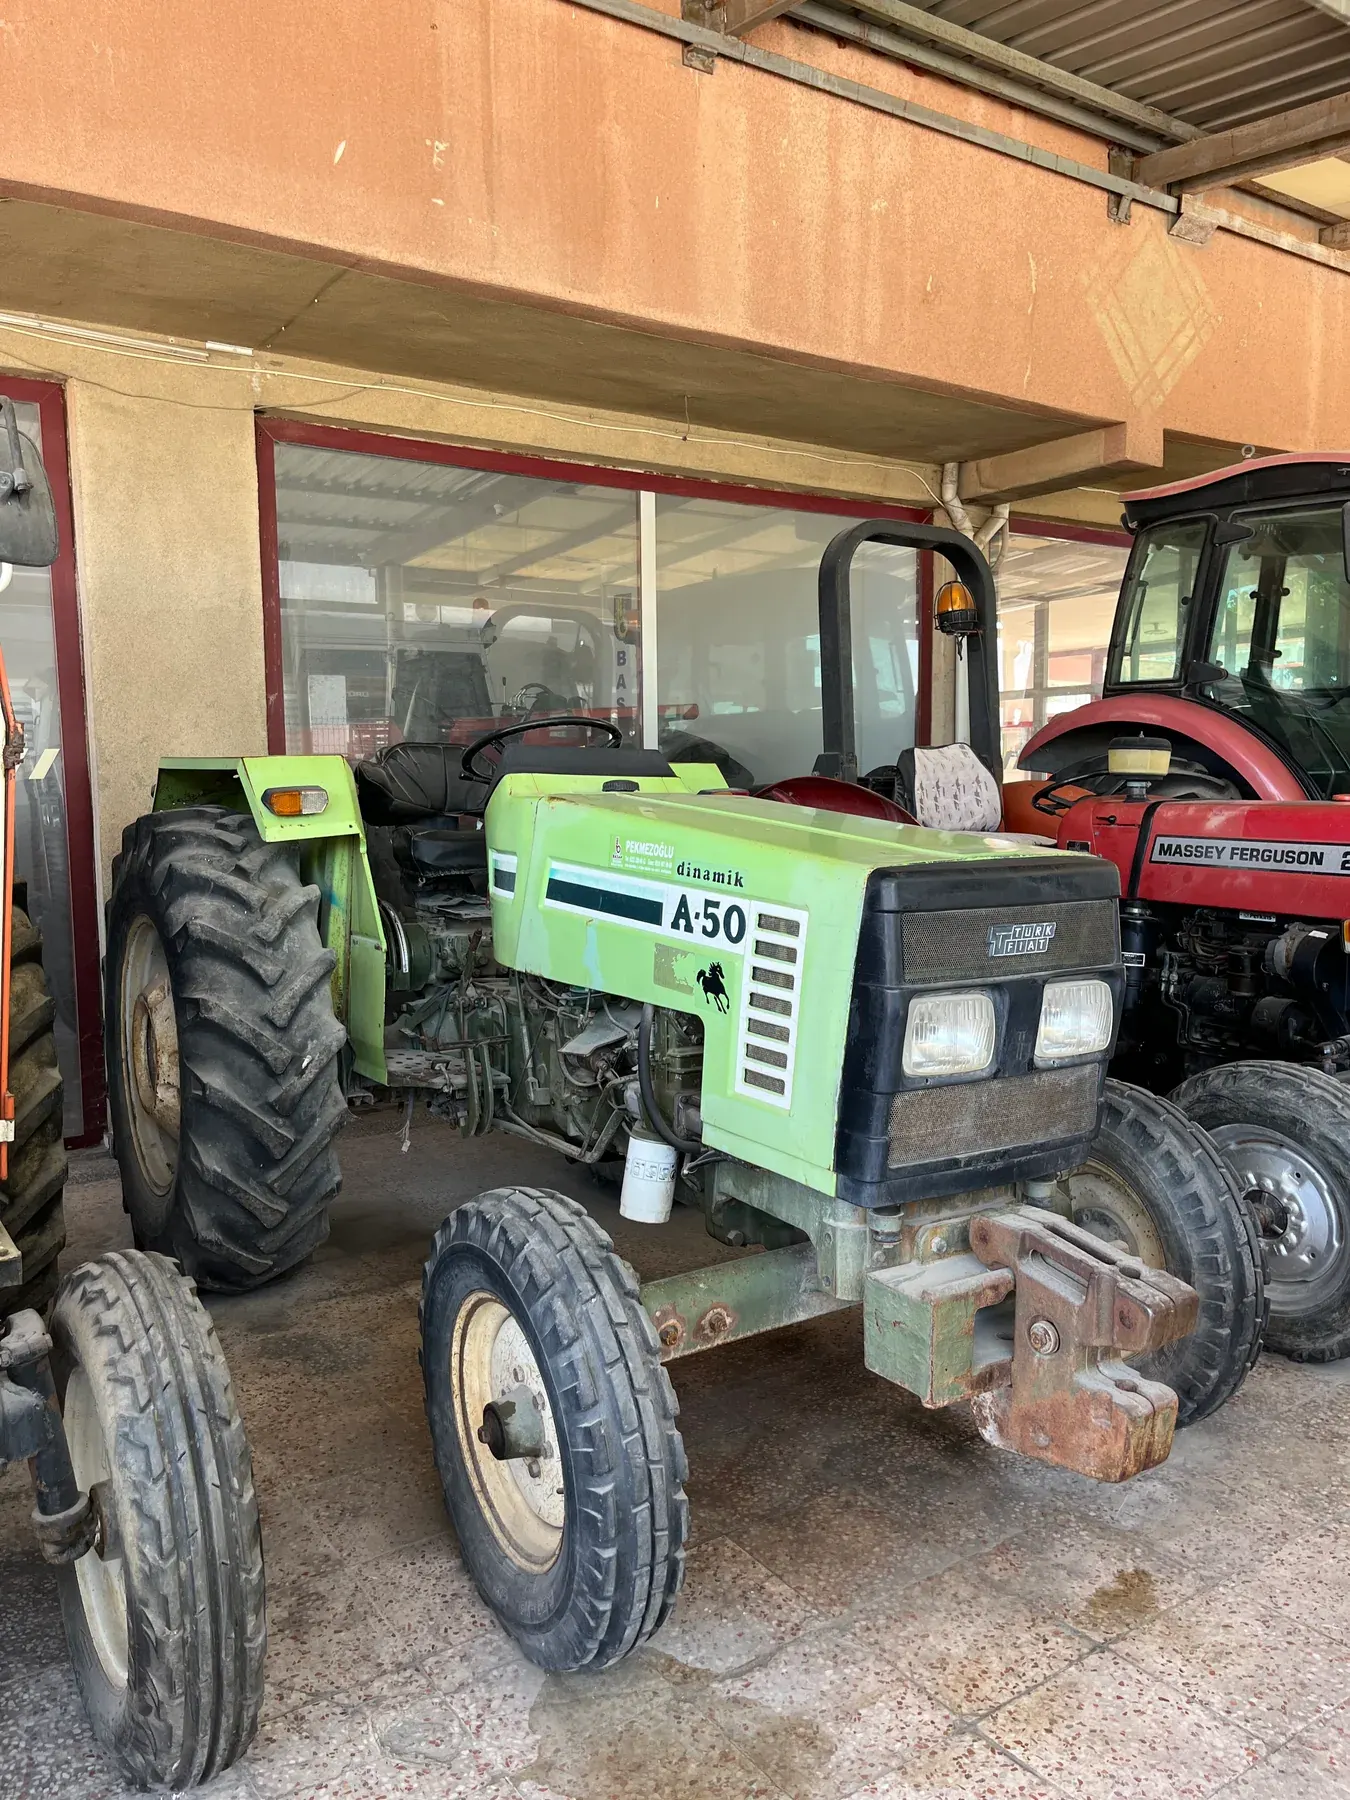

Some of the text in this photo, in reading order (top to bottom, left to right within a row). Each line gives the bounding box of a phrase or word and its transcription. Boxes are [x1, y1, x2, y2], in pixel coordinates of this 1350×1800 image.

[625, 840, 674, 858] PEKMEZOĞLU
[1158, 843, 1226, 860] MASSEY
[1229, 846, 1325, 867] FERGUSON
[676, 861, 744, 888] dinamik
[1007, 940, 1045, 953] FIAT
